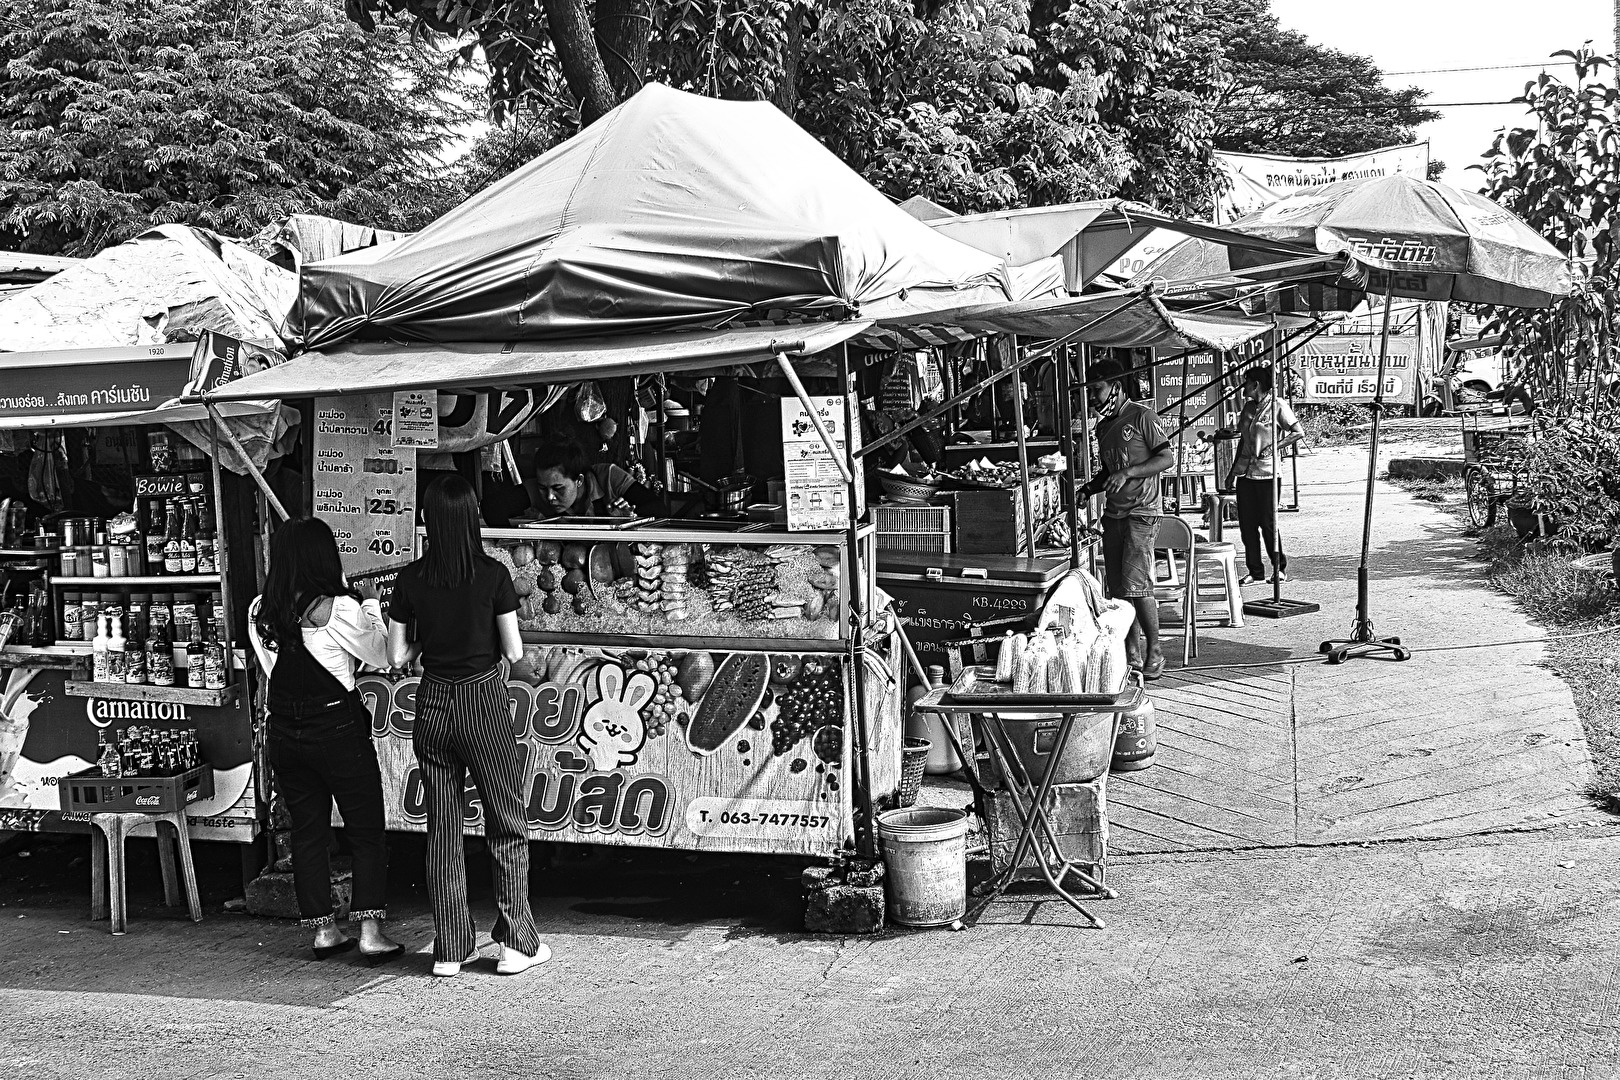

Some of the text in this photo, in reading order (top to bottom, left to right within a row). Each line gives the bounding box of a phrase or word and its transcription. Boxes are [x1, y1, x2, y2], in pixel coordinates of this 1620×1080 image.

[149, 348, 164, 356] 1920
[1357, 378, 1396, 393] เร็วนี้
[0, 385, 150, 408] วามอร่อย...สังเกต คาร์เนชัน
[138, 477, 183, 494] Bowie
[87, 697, 186, 728] Carnation
[202, 816, 235, 828] taste
[700, 810, 830, 829] T. 063-7477557
